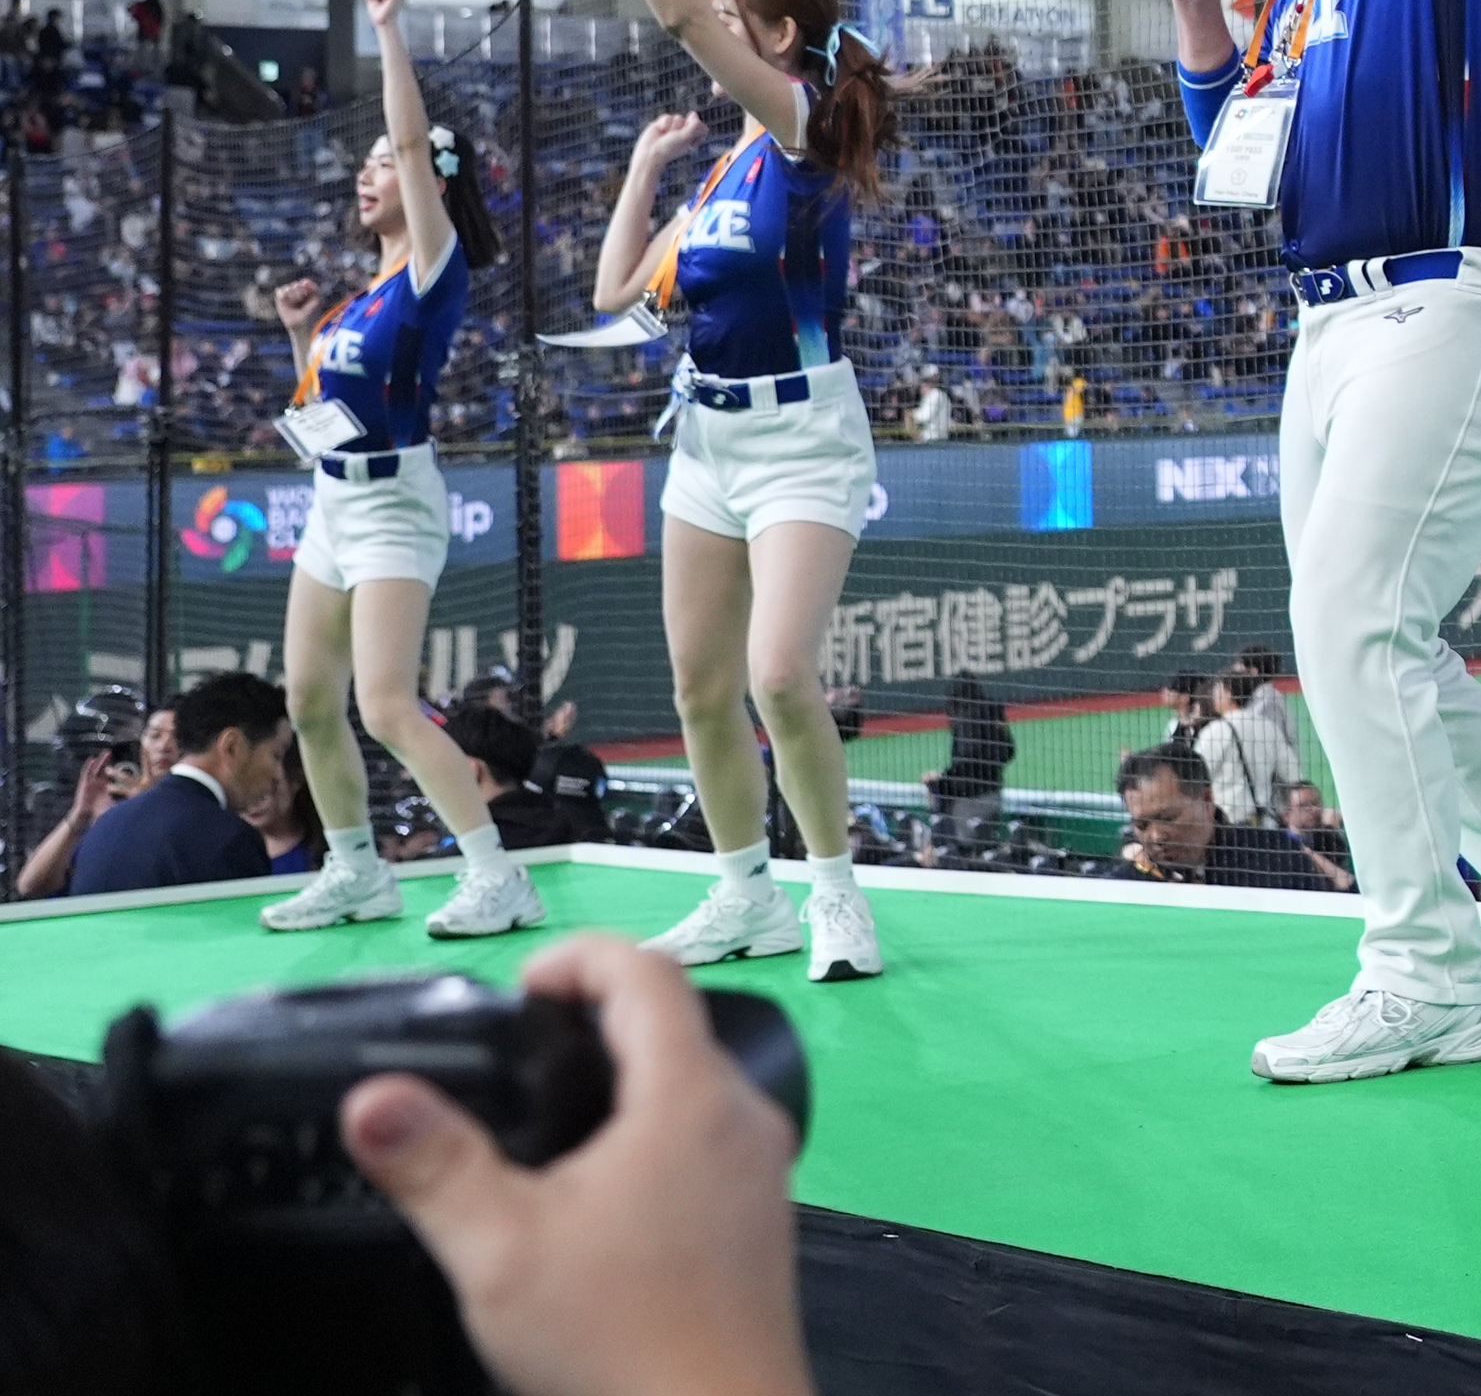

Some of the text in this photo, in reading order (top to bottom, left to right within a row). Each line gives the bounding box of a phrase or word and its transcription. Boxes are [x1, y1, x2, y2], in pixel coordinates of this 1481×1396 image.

[818, 567, 1239, 687] 新宿健診プラザ
